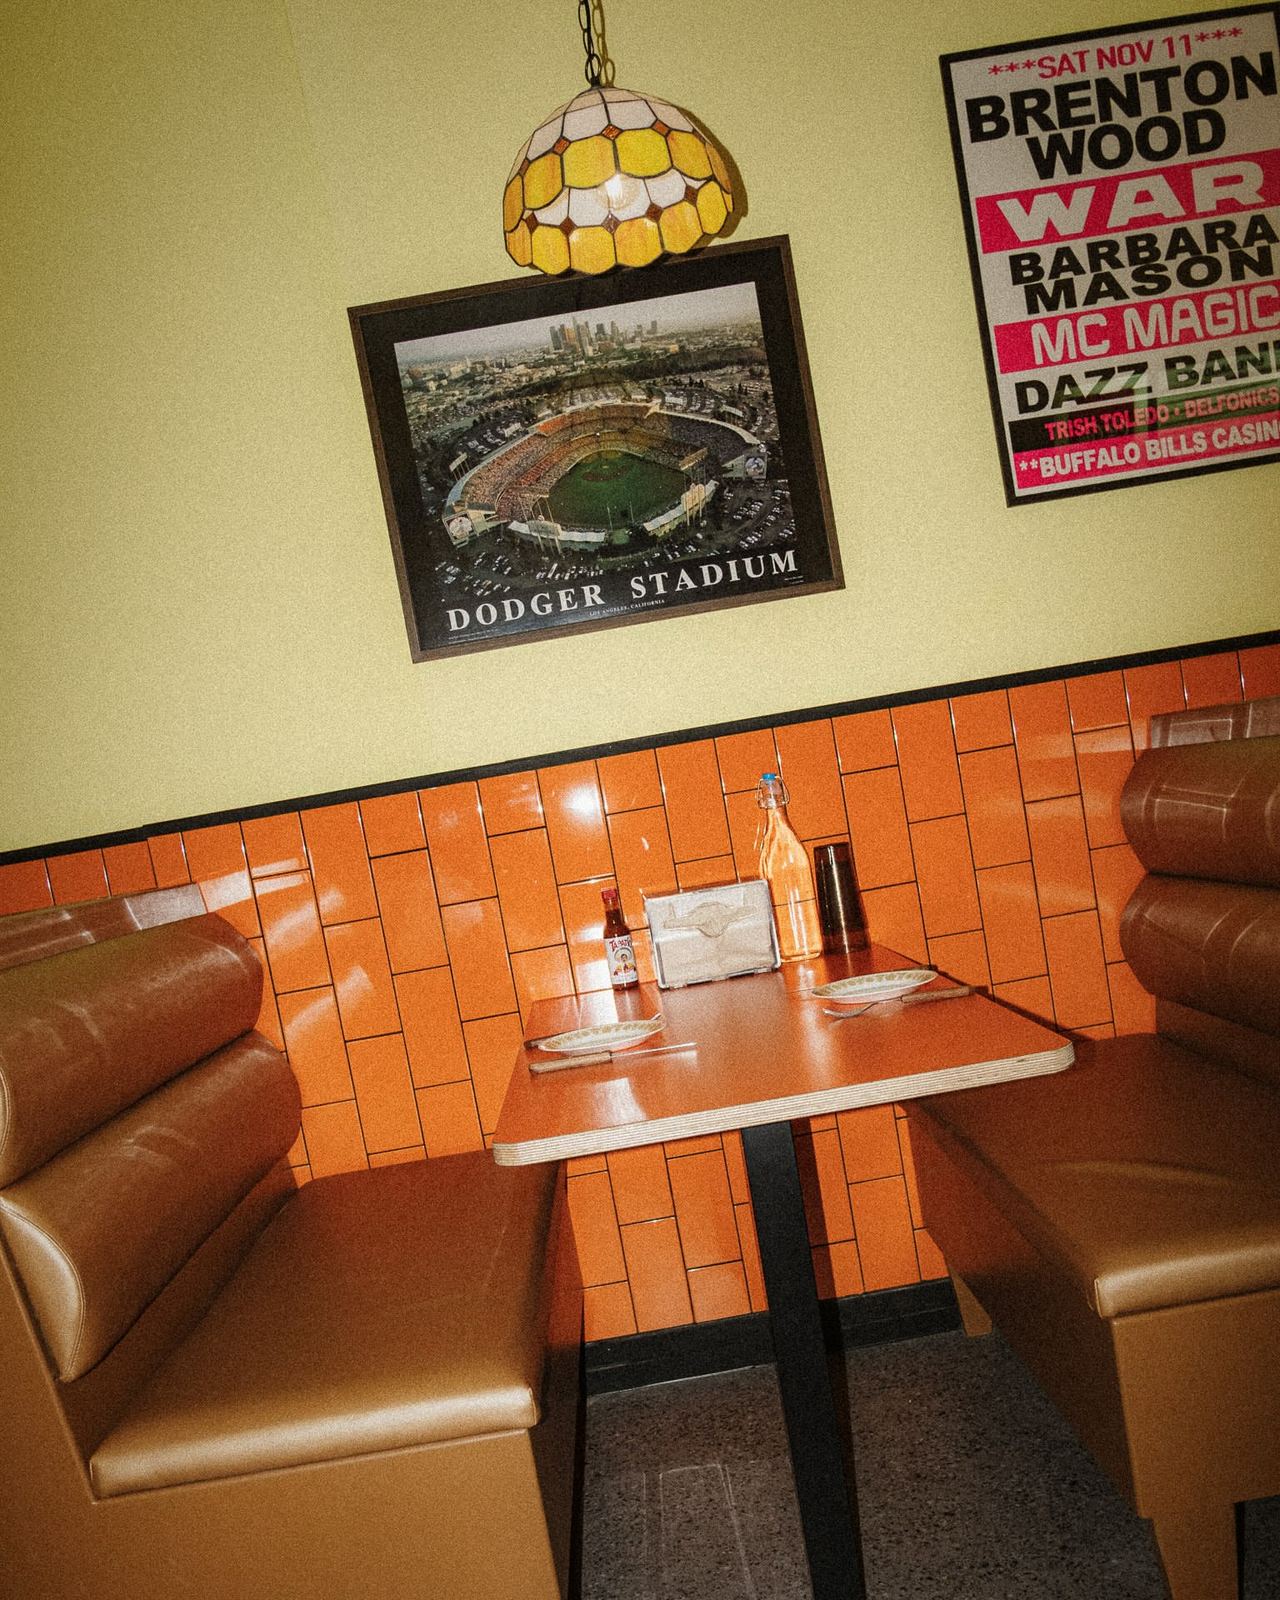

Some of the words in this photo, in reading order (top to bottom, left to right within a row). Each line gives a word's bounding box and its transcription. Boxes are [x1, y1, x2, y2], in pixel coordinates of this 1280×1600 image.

[1097, 40, 1154, 70] NOV
[965, 51, 1278, 143] BRENTON
[1025, 108, 1226, 180] WOOD
[996, 161, 1266, 242] WAR
[1009, 214, 1279, 286] BARBARA
[1024, 245, 1274, 315] MASON
[1030, 314, 1111, 365] MC
[1123, 285, 1280, 349] MAGIC
[1015, 361, 1152, 415] DAZZ
[1164, 340, 1280, 391] BAN
[1044, 416, 1098, 440] TRISH
[1100, 404, 1169, 432] TOLEDO
[1185, 386, 1280, 418] DELFONICS
[1145, 431, 1208, 461] BILLS
[1212, 419, 1280, 449] CASIN
[446, 585, 605, 631] DODGER
[630, 550, 798, 599] STADIUM
[630, 599, 665, 609] CALIFORNIA
